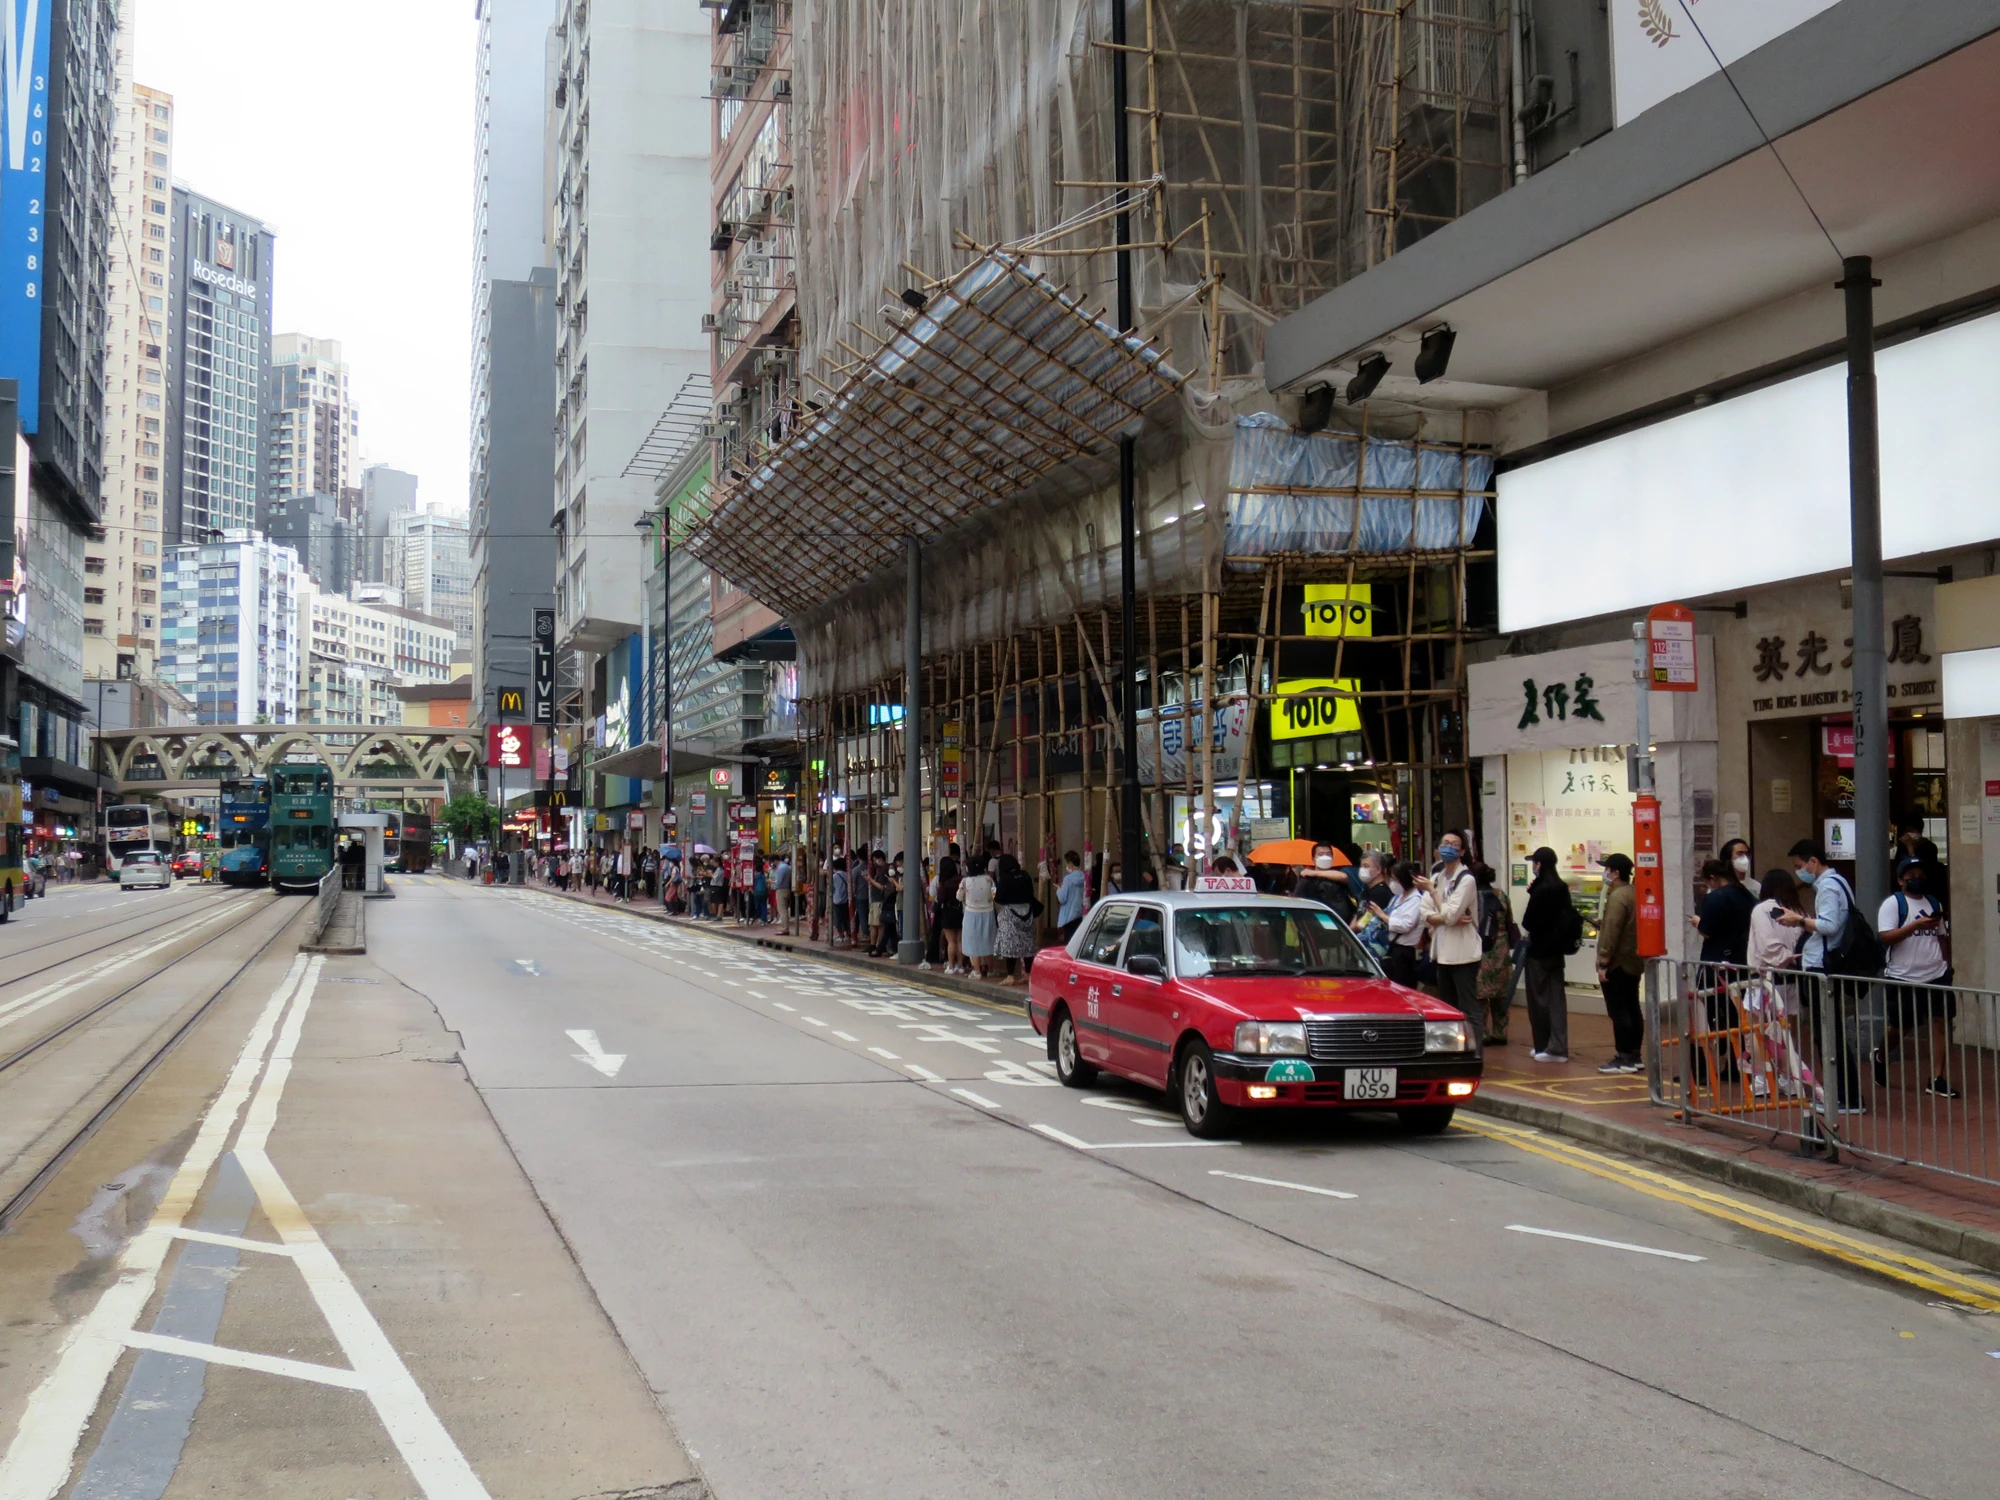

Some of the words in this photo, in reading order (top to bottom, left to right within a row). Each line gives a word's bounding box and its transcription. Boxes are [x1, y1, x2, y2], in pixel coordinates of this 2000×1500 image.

[30, 75, 45, 172] 3602
[25, 199, 40, 299] 2388
[193, 258, 256, 299] Rosedale
[1653, 641, 1667, 653] 112
[537, 642, 552, 718] LIVE
[1752, 697, 1774, 712] YING
[1801, 690, 1839, 707] MANSION
[1841, 689, 1854, 703] 2-
[1901, 680, 1936, 697] STREET
[1287, 695, 1338, 730] 1010
[1204, 878, 1252, 890] TAXI
[1087, 1001, 1099, 1020] TAXI
[1285, 1064, 1296, 1076] 4
[1360, 1069, 1383, 1083] KU
[1350, 1083, 1391, 1098] 1059
